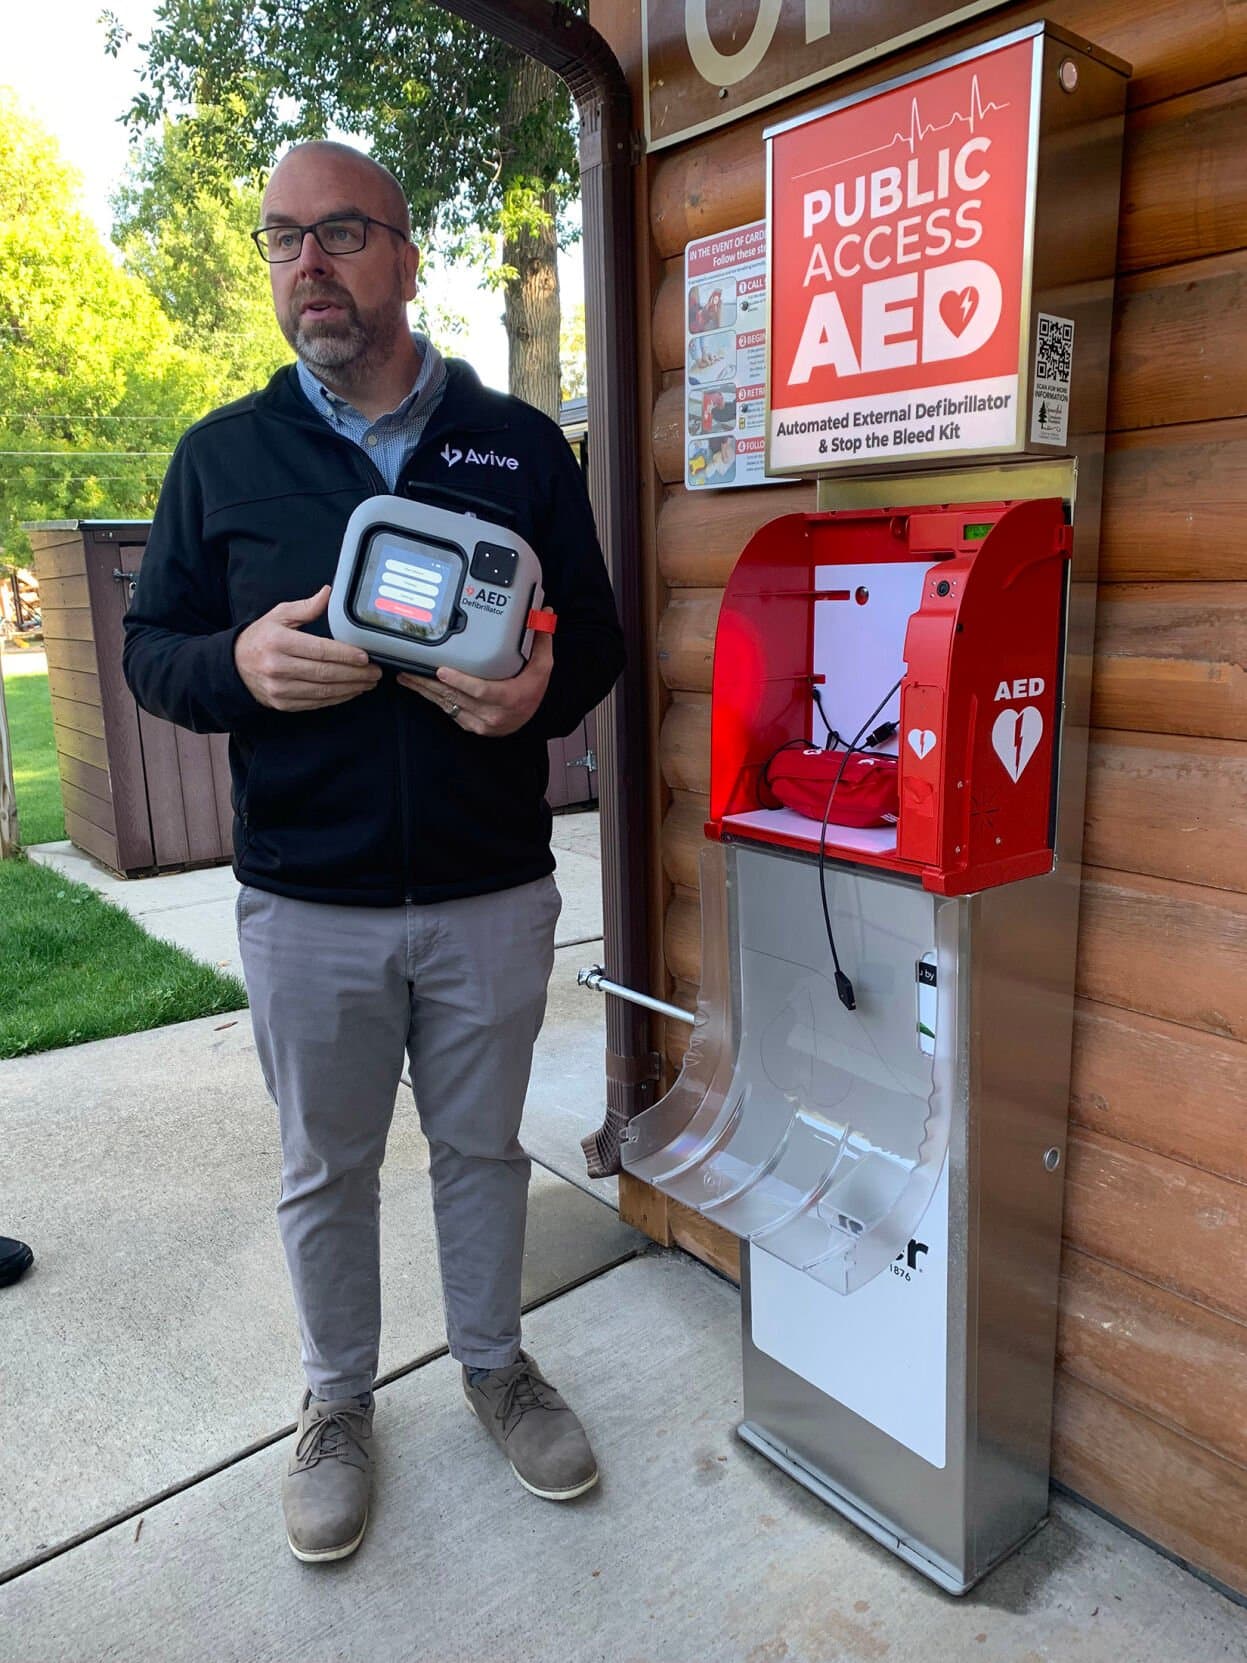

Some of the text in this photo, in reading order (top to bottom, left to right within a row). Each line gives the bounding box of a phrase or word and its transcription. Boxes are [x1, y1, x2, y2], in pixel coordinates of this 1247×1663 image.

[803, 136, 992, 239] PUBLIC
[689, 230, 766, 261] IN THE EVENT OF CARD
[802, 200, 983, 288] ACCESS
[713, 253, 736, 267] Follow
[737, 247, 757, 260] these
[747, 279, 763, 290] CALL
[786, 259, 1003, 386] AED
[776, 414, 849, 437] Automated
[853, 405, 911, 427] External
[915, 394, 1012, 420] Defibrillator
[746, 440, 766, 450] FOLLO
[818, 422, 961, 454] & Stop the Bleed Kit
[465, 448, 519, 470] Avive
[462, 597, 505, 616] Defibrillator
[475, 588, 507, 607] AED
[994, 677, 1045, 701] AED
[889, 1263, 912, 1283] 1876
